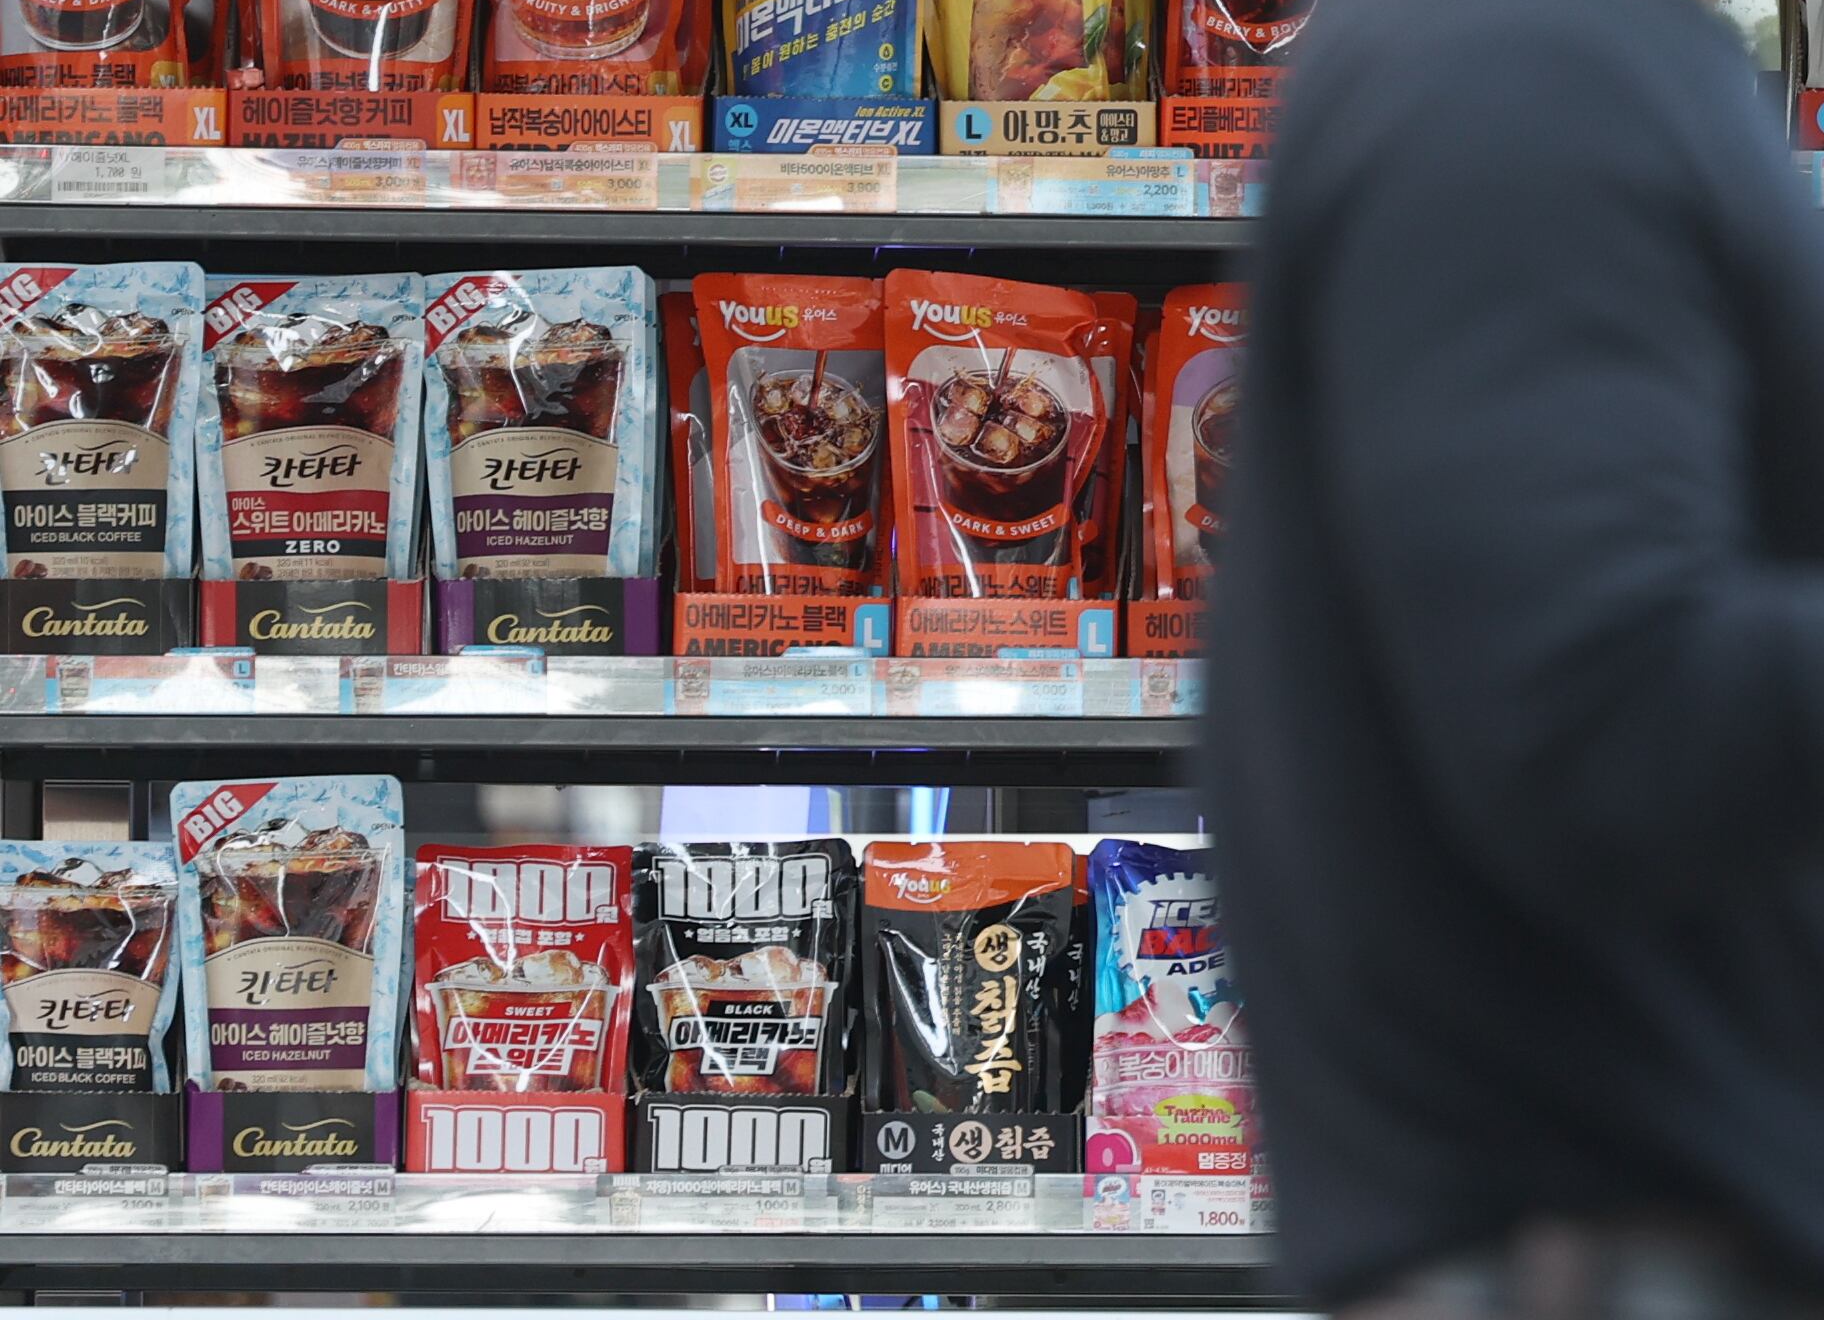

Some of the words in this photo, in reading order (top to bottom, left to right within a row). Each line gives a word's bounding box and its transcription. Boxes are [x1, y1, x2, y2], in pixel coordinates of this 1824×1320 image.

[570, 5, 581, 17] &
[192, 107, 221, 140] XL
[442, 109, 471, 143] XL
[729, 113, 753, 128] XL
[667, 120, 696, 152] XL
[205, 285, 264, 336] BIG
[427, 280, 485, 335] BIG
[719, 299, 799, 330] youus
[802, 306, 838, 322] 유어스
[14, 503, 75, 528] 아이스
[77, 503, 157, 528] 블랙커피
[231, 497, 266, 510] 아이스
[232, 512, 291, 535] 스위트
[292, 511, 387, 535] 아메리카노
[457, 510, 510, 534] 아이스
[512, 509, 608, 533] 헤이즐넛향
[775, 515, 811, 537] DEEP
[815, 526, 827, 538] &
[831, 521, 865, 538] DARK
[952, 512, 990, 534] DARK
[995, 524, 1006, 536] &
[1011, 515, 1056, 534] SWEET
[30, 532, 57, 543] ICED
[58, 531, 95, 543] BLACK
[98, 531, 142, 543] COFFEE
[286, 539, 341, 554] ZERO
[486, 536, 513, 546] ICED
[514, 534, 575, 547] HAZELNUT
[686, 604, 801, 631] 아메리카노
[803, 604, 847, 632] 블랙
[864, 618, 882, 648] L
[1150, 898, 1221, 928] ICE
[1024, 930, 1049, 1001] 국내산
[1166, 957, 1226, 976] ADE
[505, 1006, 556, 1018] SWEET
[724, 1004, 773, 1016] BLACK
[211, 1023, 267, 1046] 아이스
[268, 1022, 365, 1046] 헤이즐넛향
[16, 1045, 74, 1069] 아이스
[75, 1046, 147, 1071] 블랙커피
[242, 1050, 269, 1061] ICED
[271, 1049, 332, 1061] HAZELNUT
[31, 1073, 58, 1083] ICED
[59, 1072, 93, 1084] BLACK
[94, 1073, 136, 1085] COFFEE
[10, 1127, 136, 1157] Cantata
[233, 1127, 358, 1157] Cantata
[883, 1127, 908, 1149] M
[1197, 1211, 1238, 1227] 1,800
